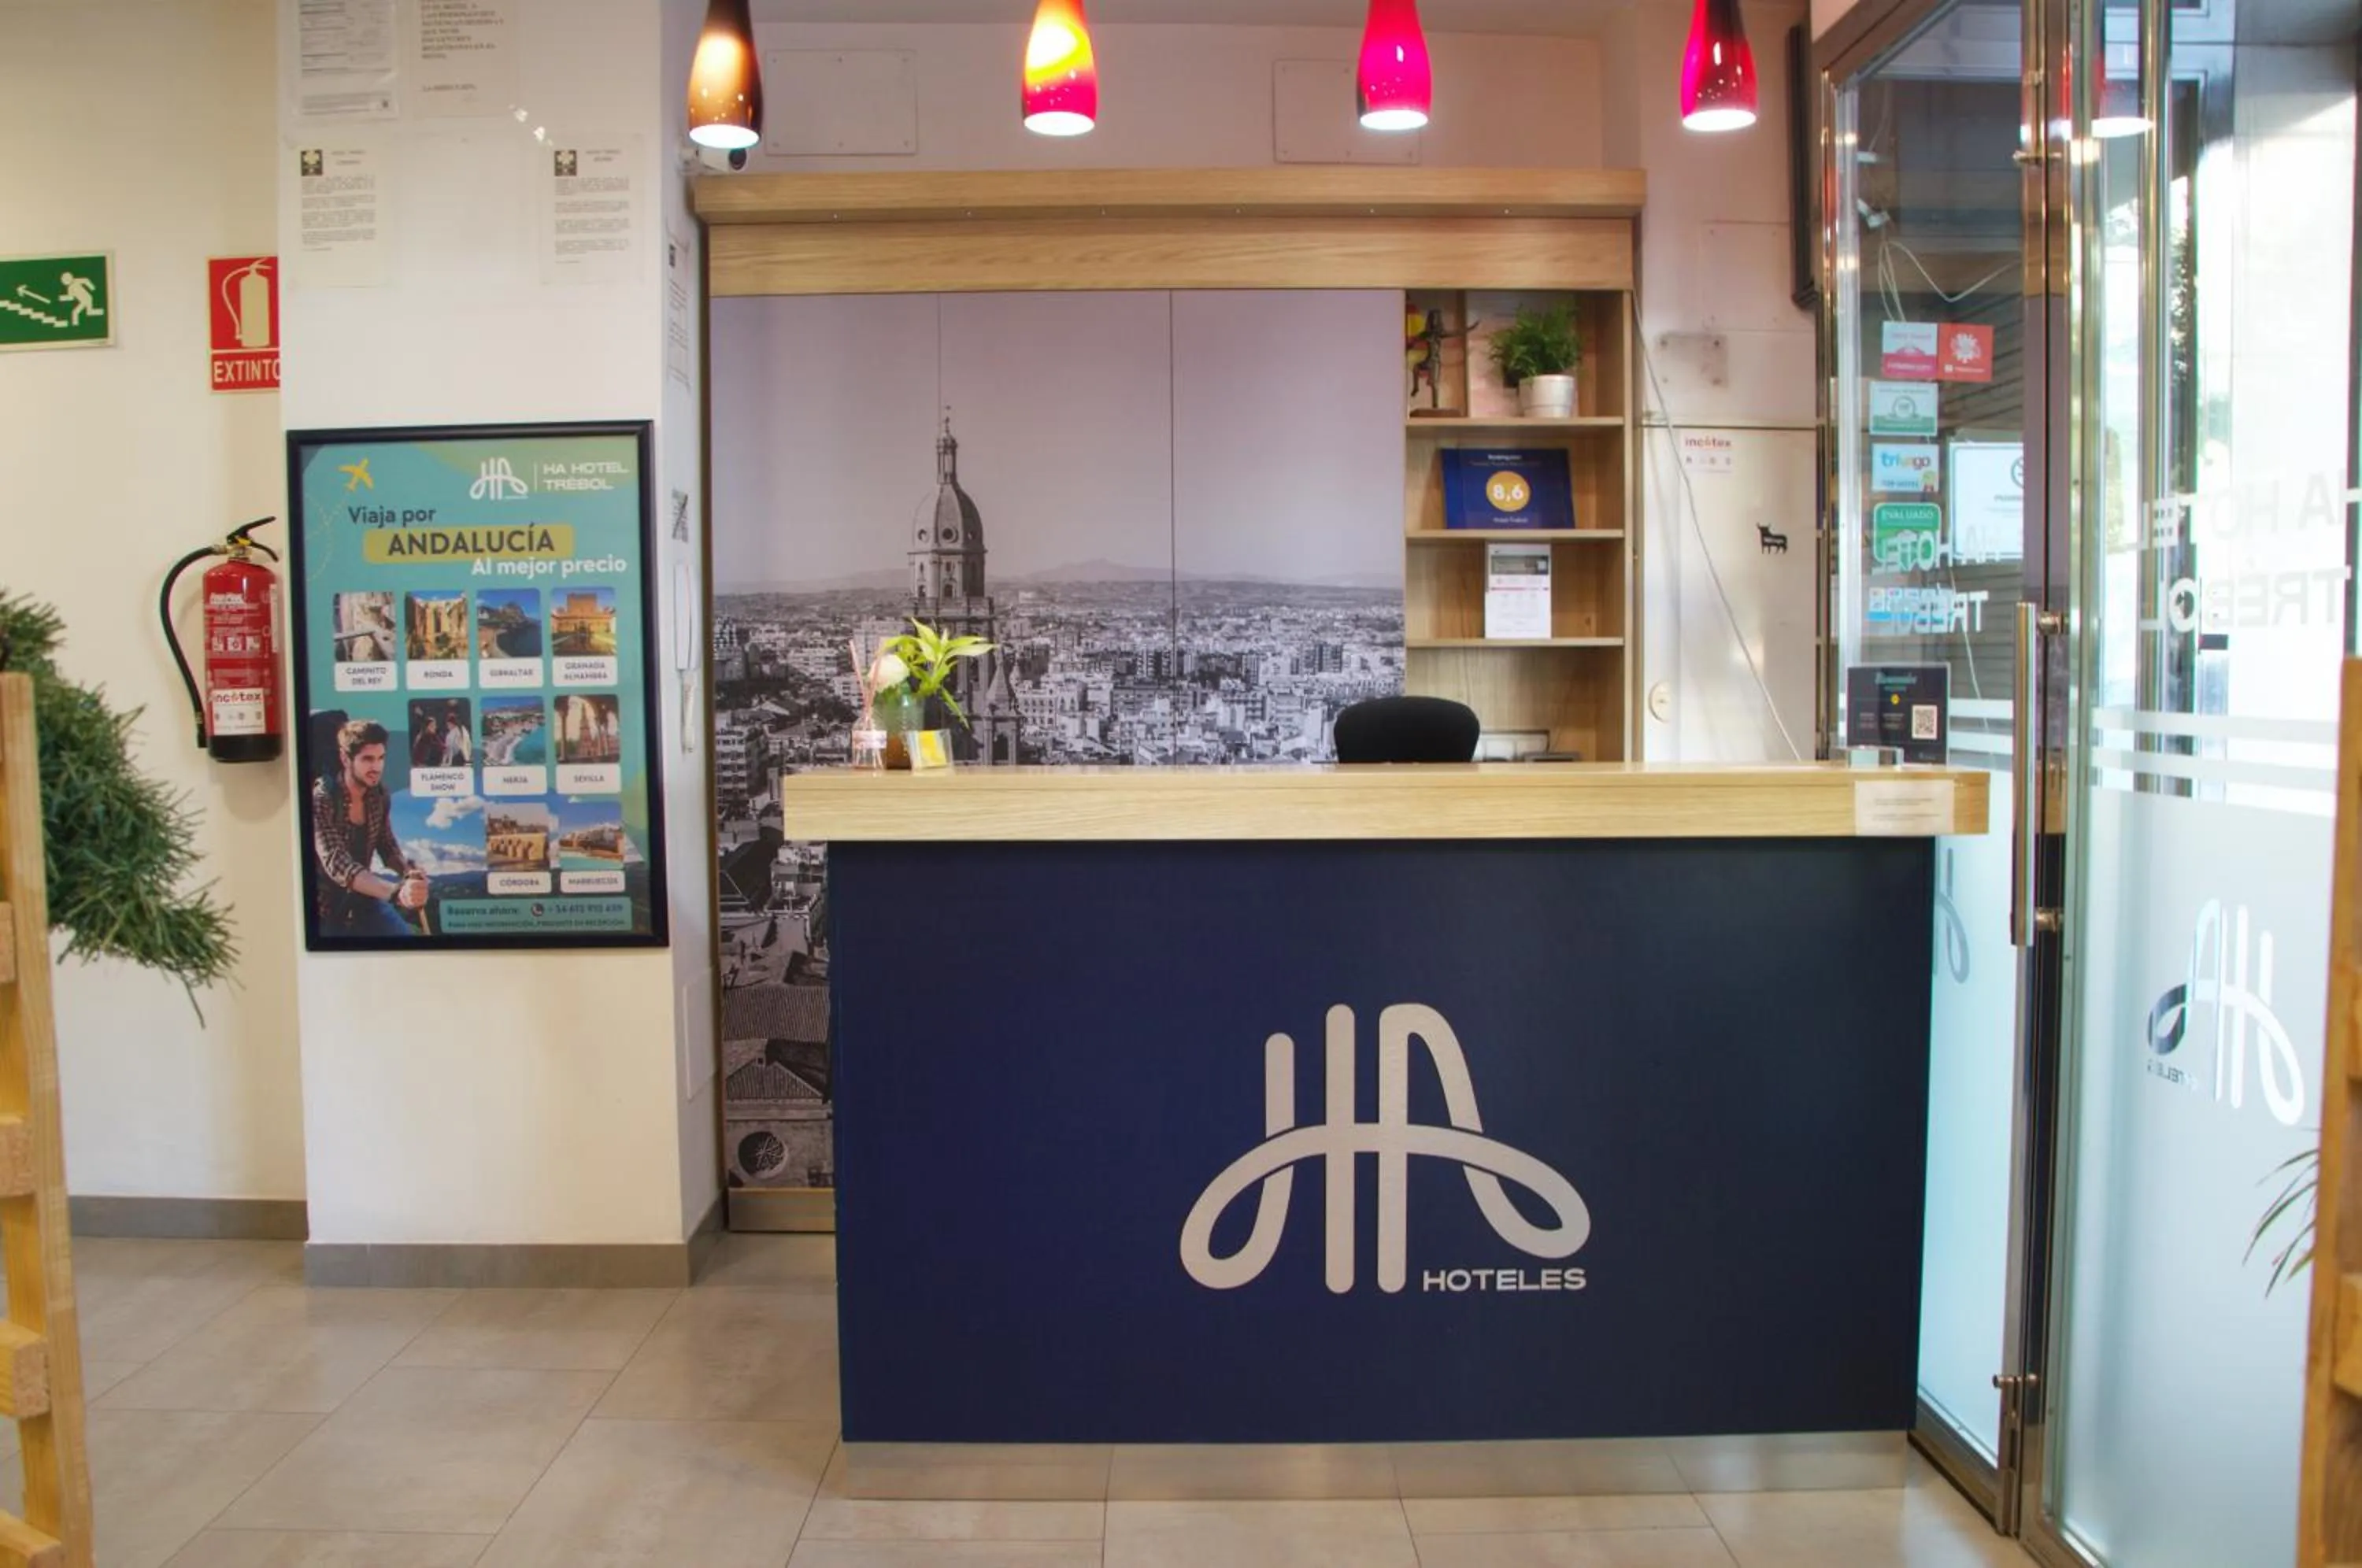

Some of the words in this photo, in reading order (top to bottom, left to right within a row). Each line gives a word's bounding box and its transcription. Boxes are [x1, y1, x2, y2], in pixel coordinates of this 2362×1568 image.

[543, 463, 568, 475] HA
[571, 461, 630, 474] HOTEL
[1493, 483, 1523, 503] 8,6
[347, 506, 396, 528] Viaja
[402, 508, 436, 527] por
[387, 522, 555, 557] ANDALUCÍA
[472, 557, 492, 575] Al
[498, 557, 557, 580] mejor
[561, 553, 628, 578] precio
[420, 772, 465, 782] FLAMENCO
[1423, 1267, 1587, 1292] HOTELES
